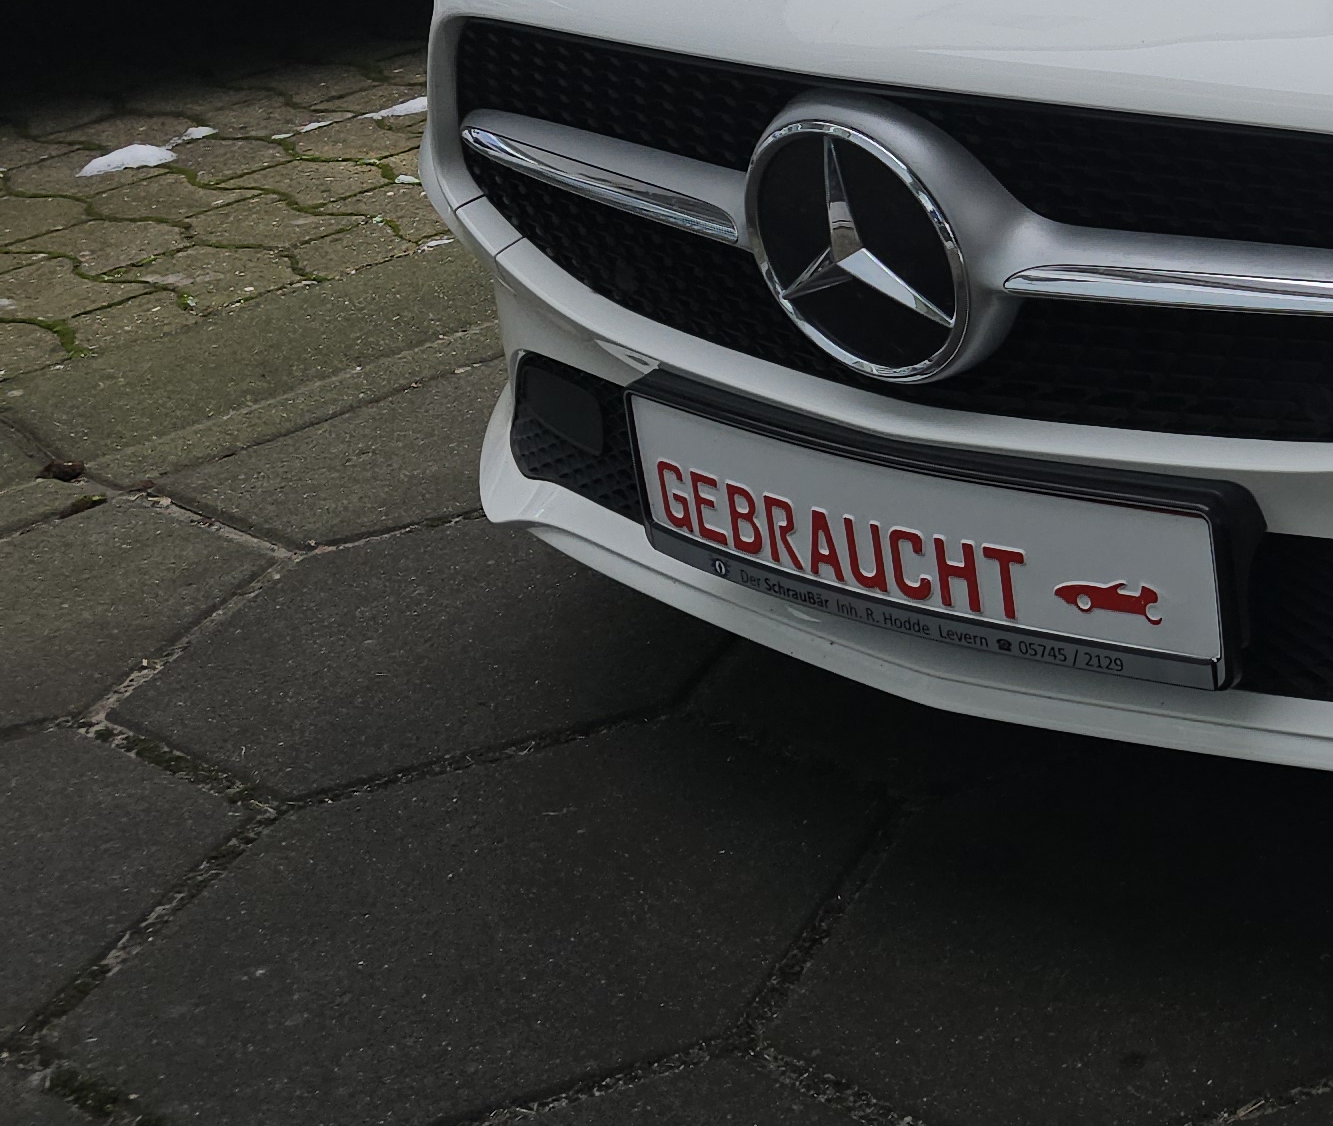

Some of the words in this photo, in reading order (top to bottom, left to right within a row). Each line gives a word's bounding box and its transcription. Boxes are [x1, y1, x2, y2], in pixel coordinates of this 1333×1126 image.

[656, 459, 1025, 621] GEBRAUCHT
[740, 569, 761, 588] Der
[837, 598, 863, 619] Inh.
[866, 607, 880, 623] R.
[882, 611, 931, 636] Hodde
[938, 624, 989, 648] Levern
[1018, 640, 1068, 662] 05745
[1084, 652, 1124, 672] 2129
